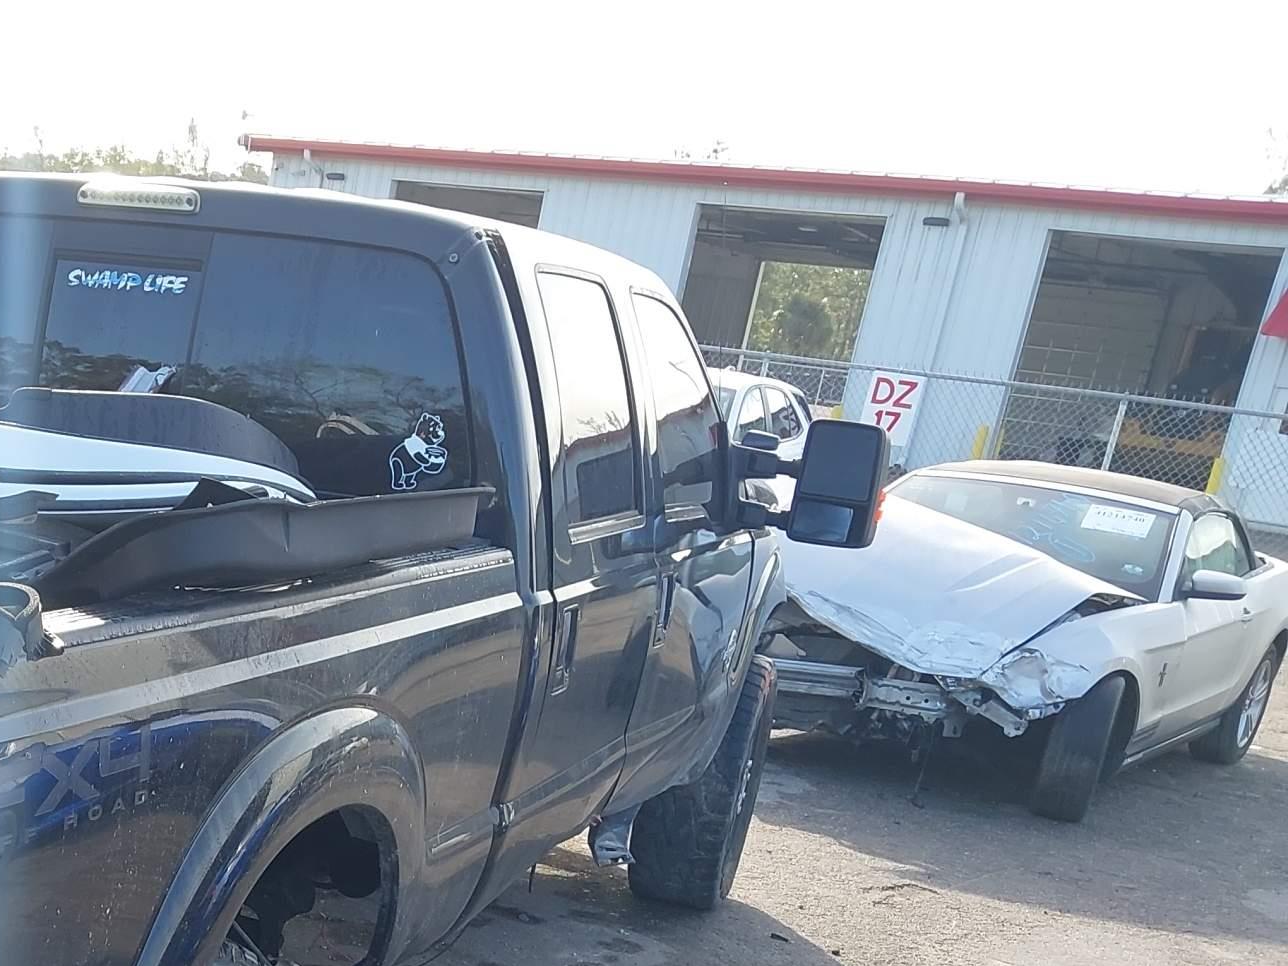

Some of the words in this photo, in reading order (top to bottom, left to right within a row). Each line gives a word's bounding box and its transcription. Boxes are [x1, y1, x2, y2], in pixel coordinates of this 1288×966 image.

[67, 268, 143, 291] SWAMP
[143, 273, 189, 294] LIFE
[871, 376, 919, 409] DZ
[874, 409, 902, 433] 17
[63, 789, 149, 831] ROAD
